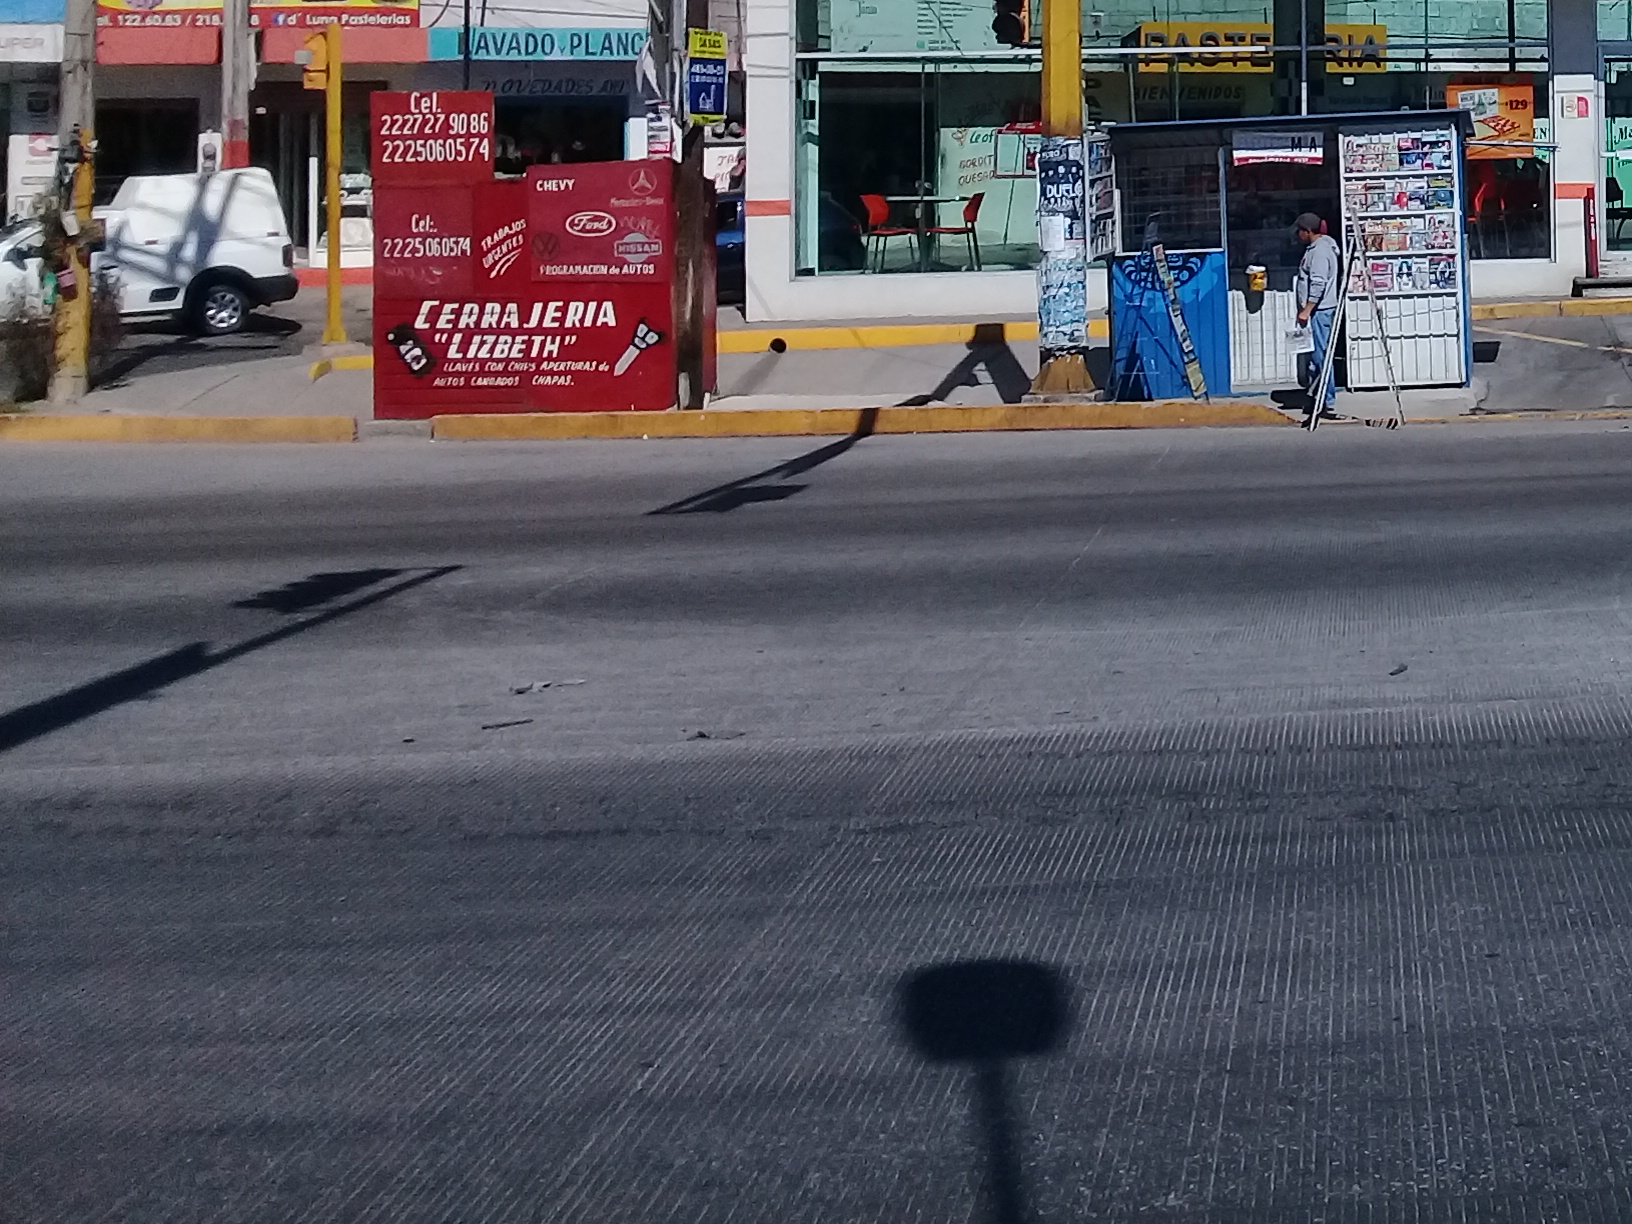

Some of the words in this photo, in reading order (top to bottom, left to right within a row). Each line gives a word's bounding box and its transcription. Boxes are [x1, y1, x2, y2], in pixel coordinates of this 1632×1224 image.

[306, 14, 339, 26] Luna
[569, 32, 652, 56] PLANC
[409, 91, 442, 114] Cel.
[381, 137, 490, 163] 2225060574
[536, 178, 576, 192] CHEVY
[573, 215, 609, 231] Ford
[480, 218, 527, 252] TRABAJOS
[382, 236, 472, 258] 2225060574
[617, 242, 660, 253] NISSAN
[608, 263, 621, 275] de
[621, 263, 655, 275] AUTOS
[413, 300, 617, 330] CERRAJERIA
[443, 361, 480, 373] LLAVES
[484, 361, 505, 372] CON
[539, 360, 597, 372] APERTURAS
[431, 375, 466, 387] AUTOS
[531, 374, 575, 387] CHAPAS.
